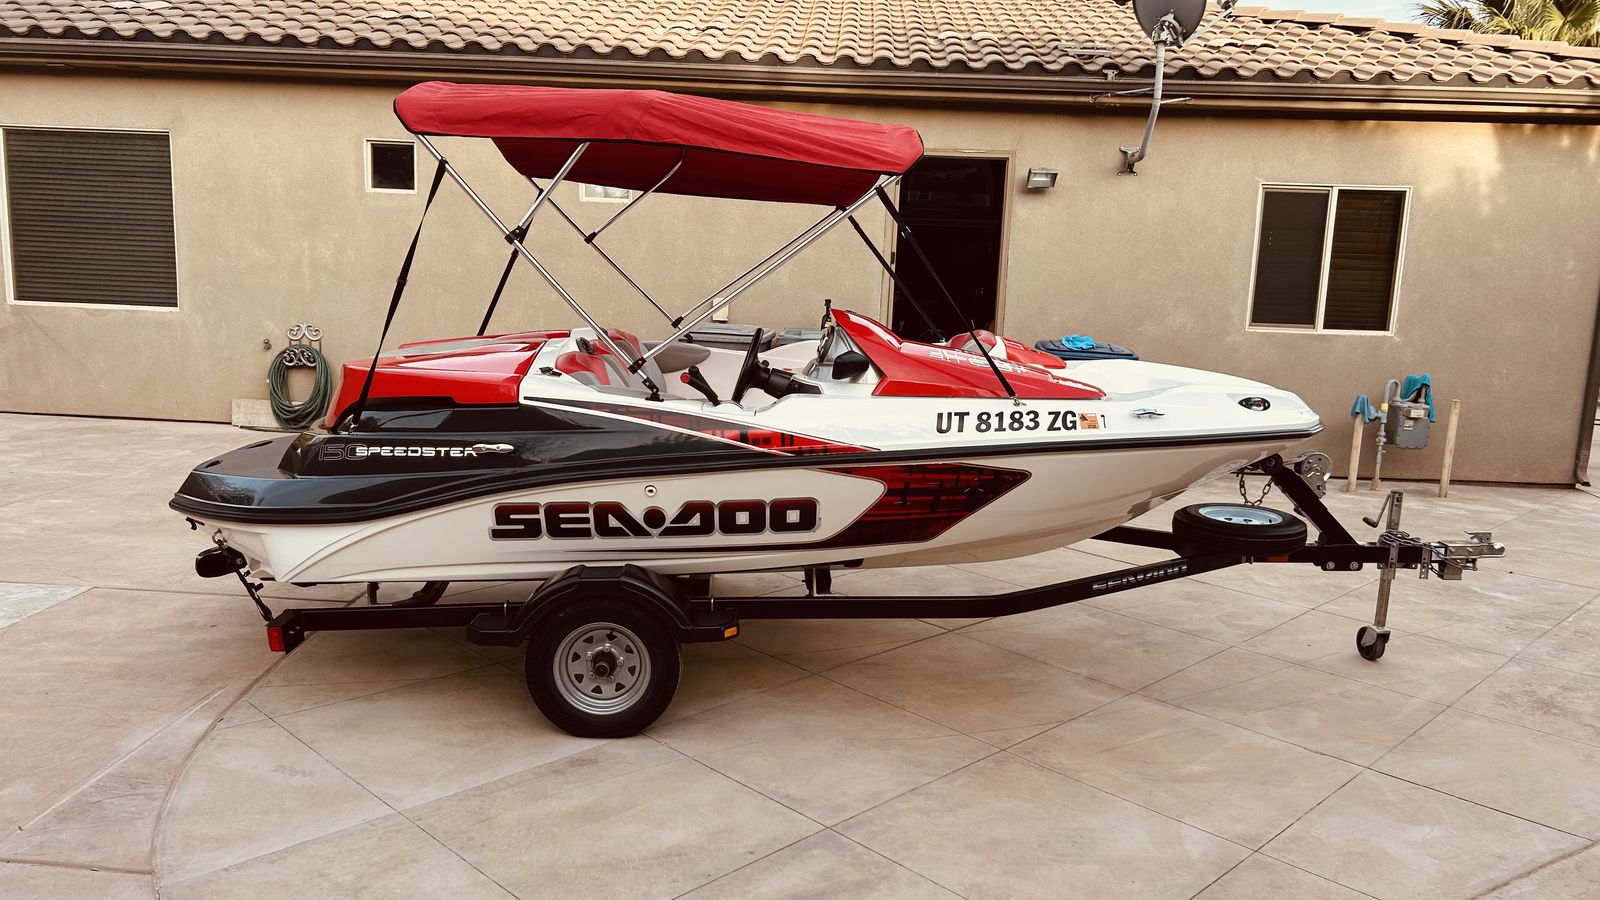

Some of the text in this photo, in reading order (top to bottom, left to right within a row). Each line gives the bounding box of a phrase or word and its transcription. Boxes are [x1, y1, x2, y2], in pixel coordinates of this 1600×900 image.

[936, 411, 970, 434] UT
[975, 410, 1040, 433] 8183
[1047, 410, 1077, 432] ZG
[355, 446, 478, 457] SPEEDSTER
